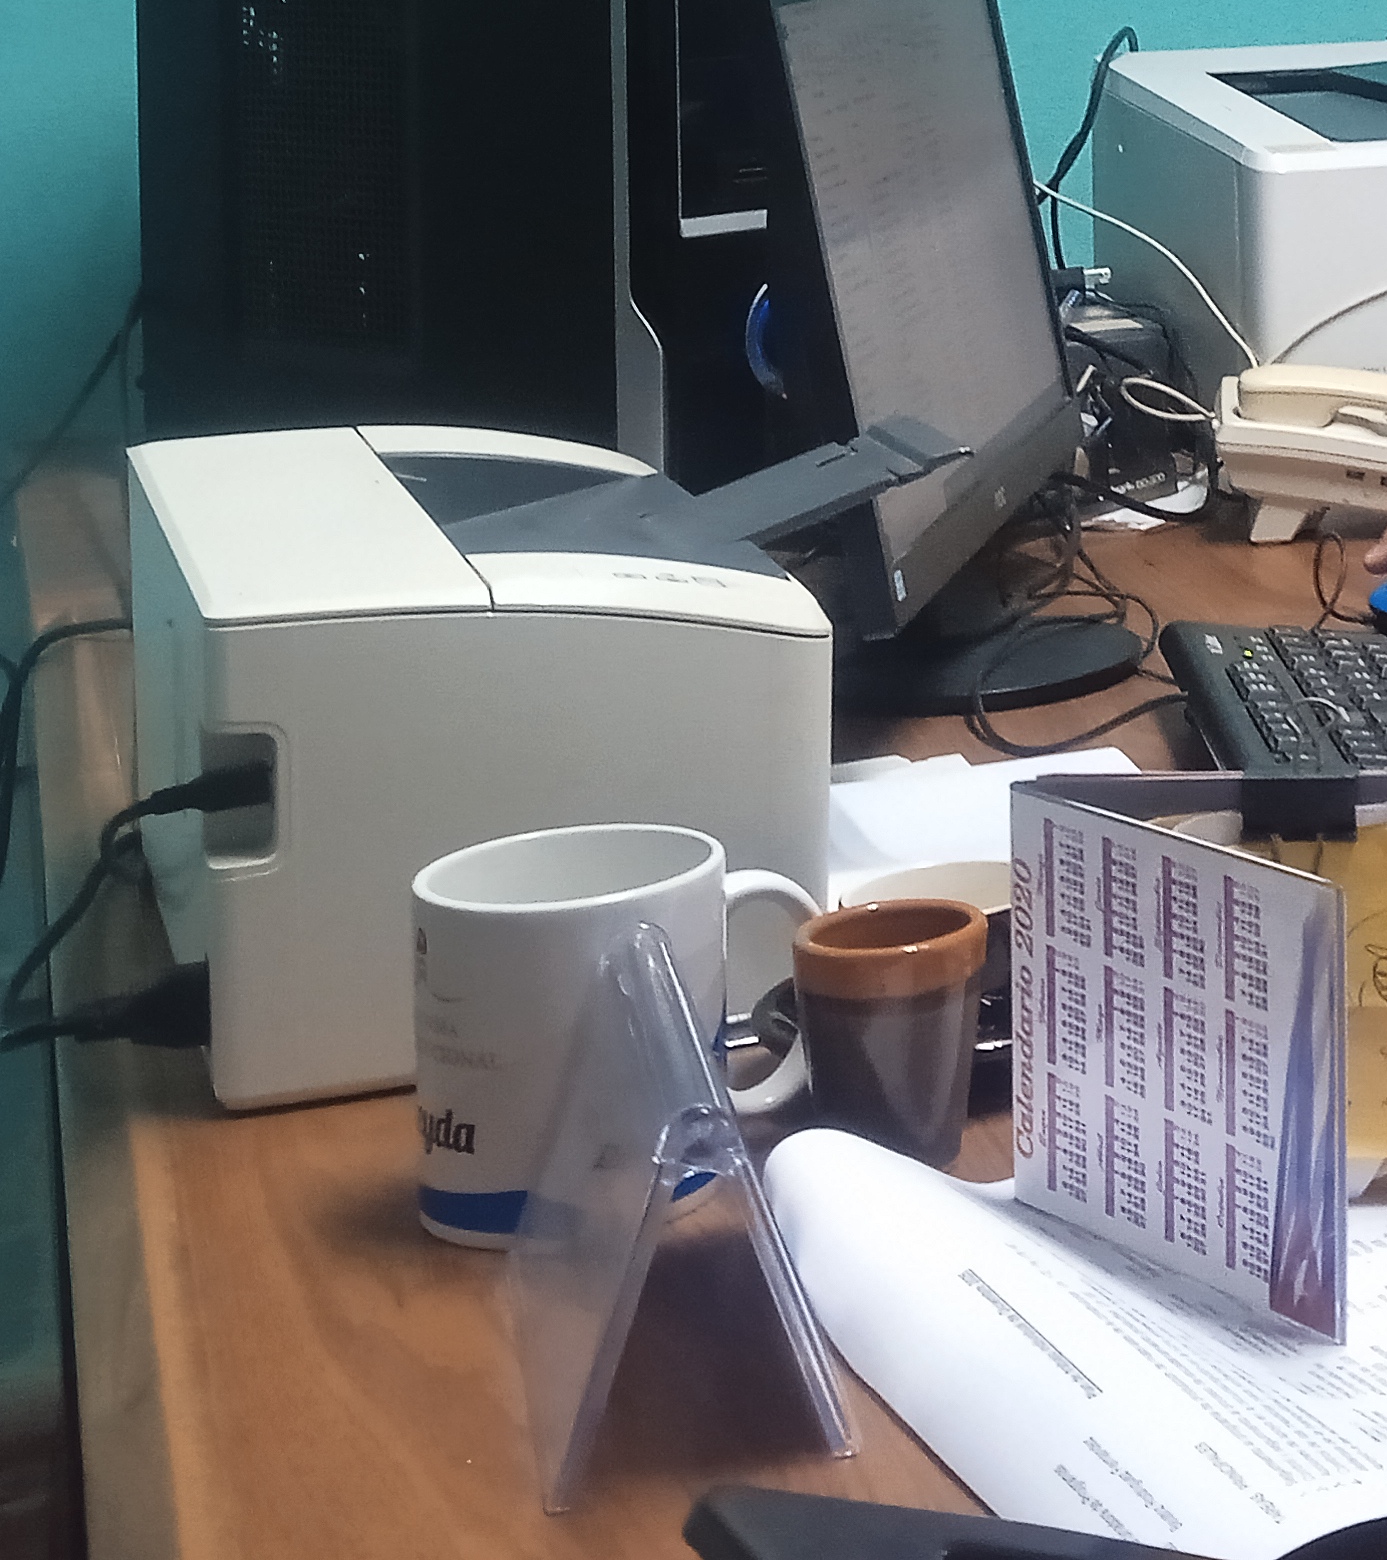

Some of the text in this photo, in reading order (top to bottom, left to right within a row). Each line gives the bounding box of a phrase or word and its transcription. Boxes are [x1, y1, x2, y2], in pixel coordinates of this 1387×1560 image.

[1012, 857, 1035, 1160] Calendario 2020
[417, 1105, 475, 1155] yda
